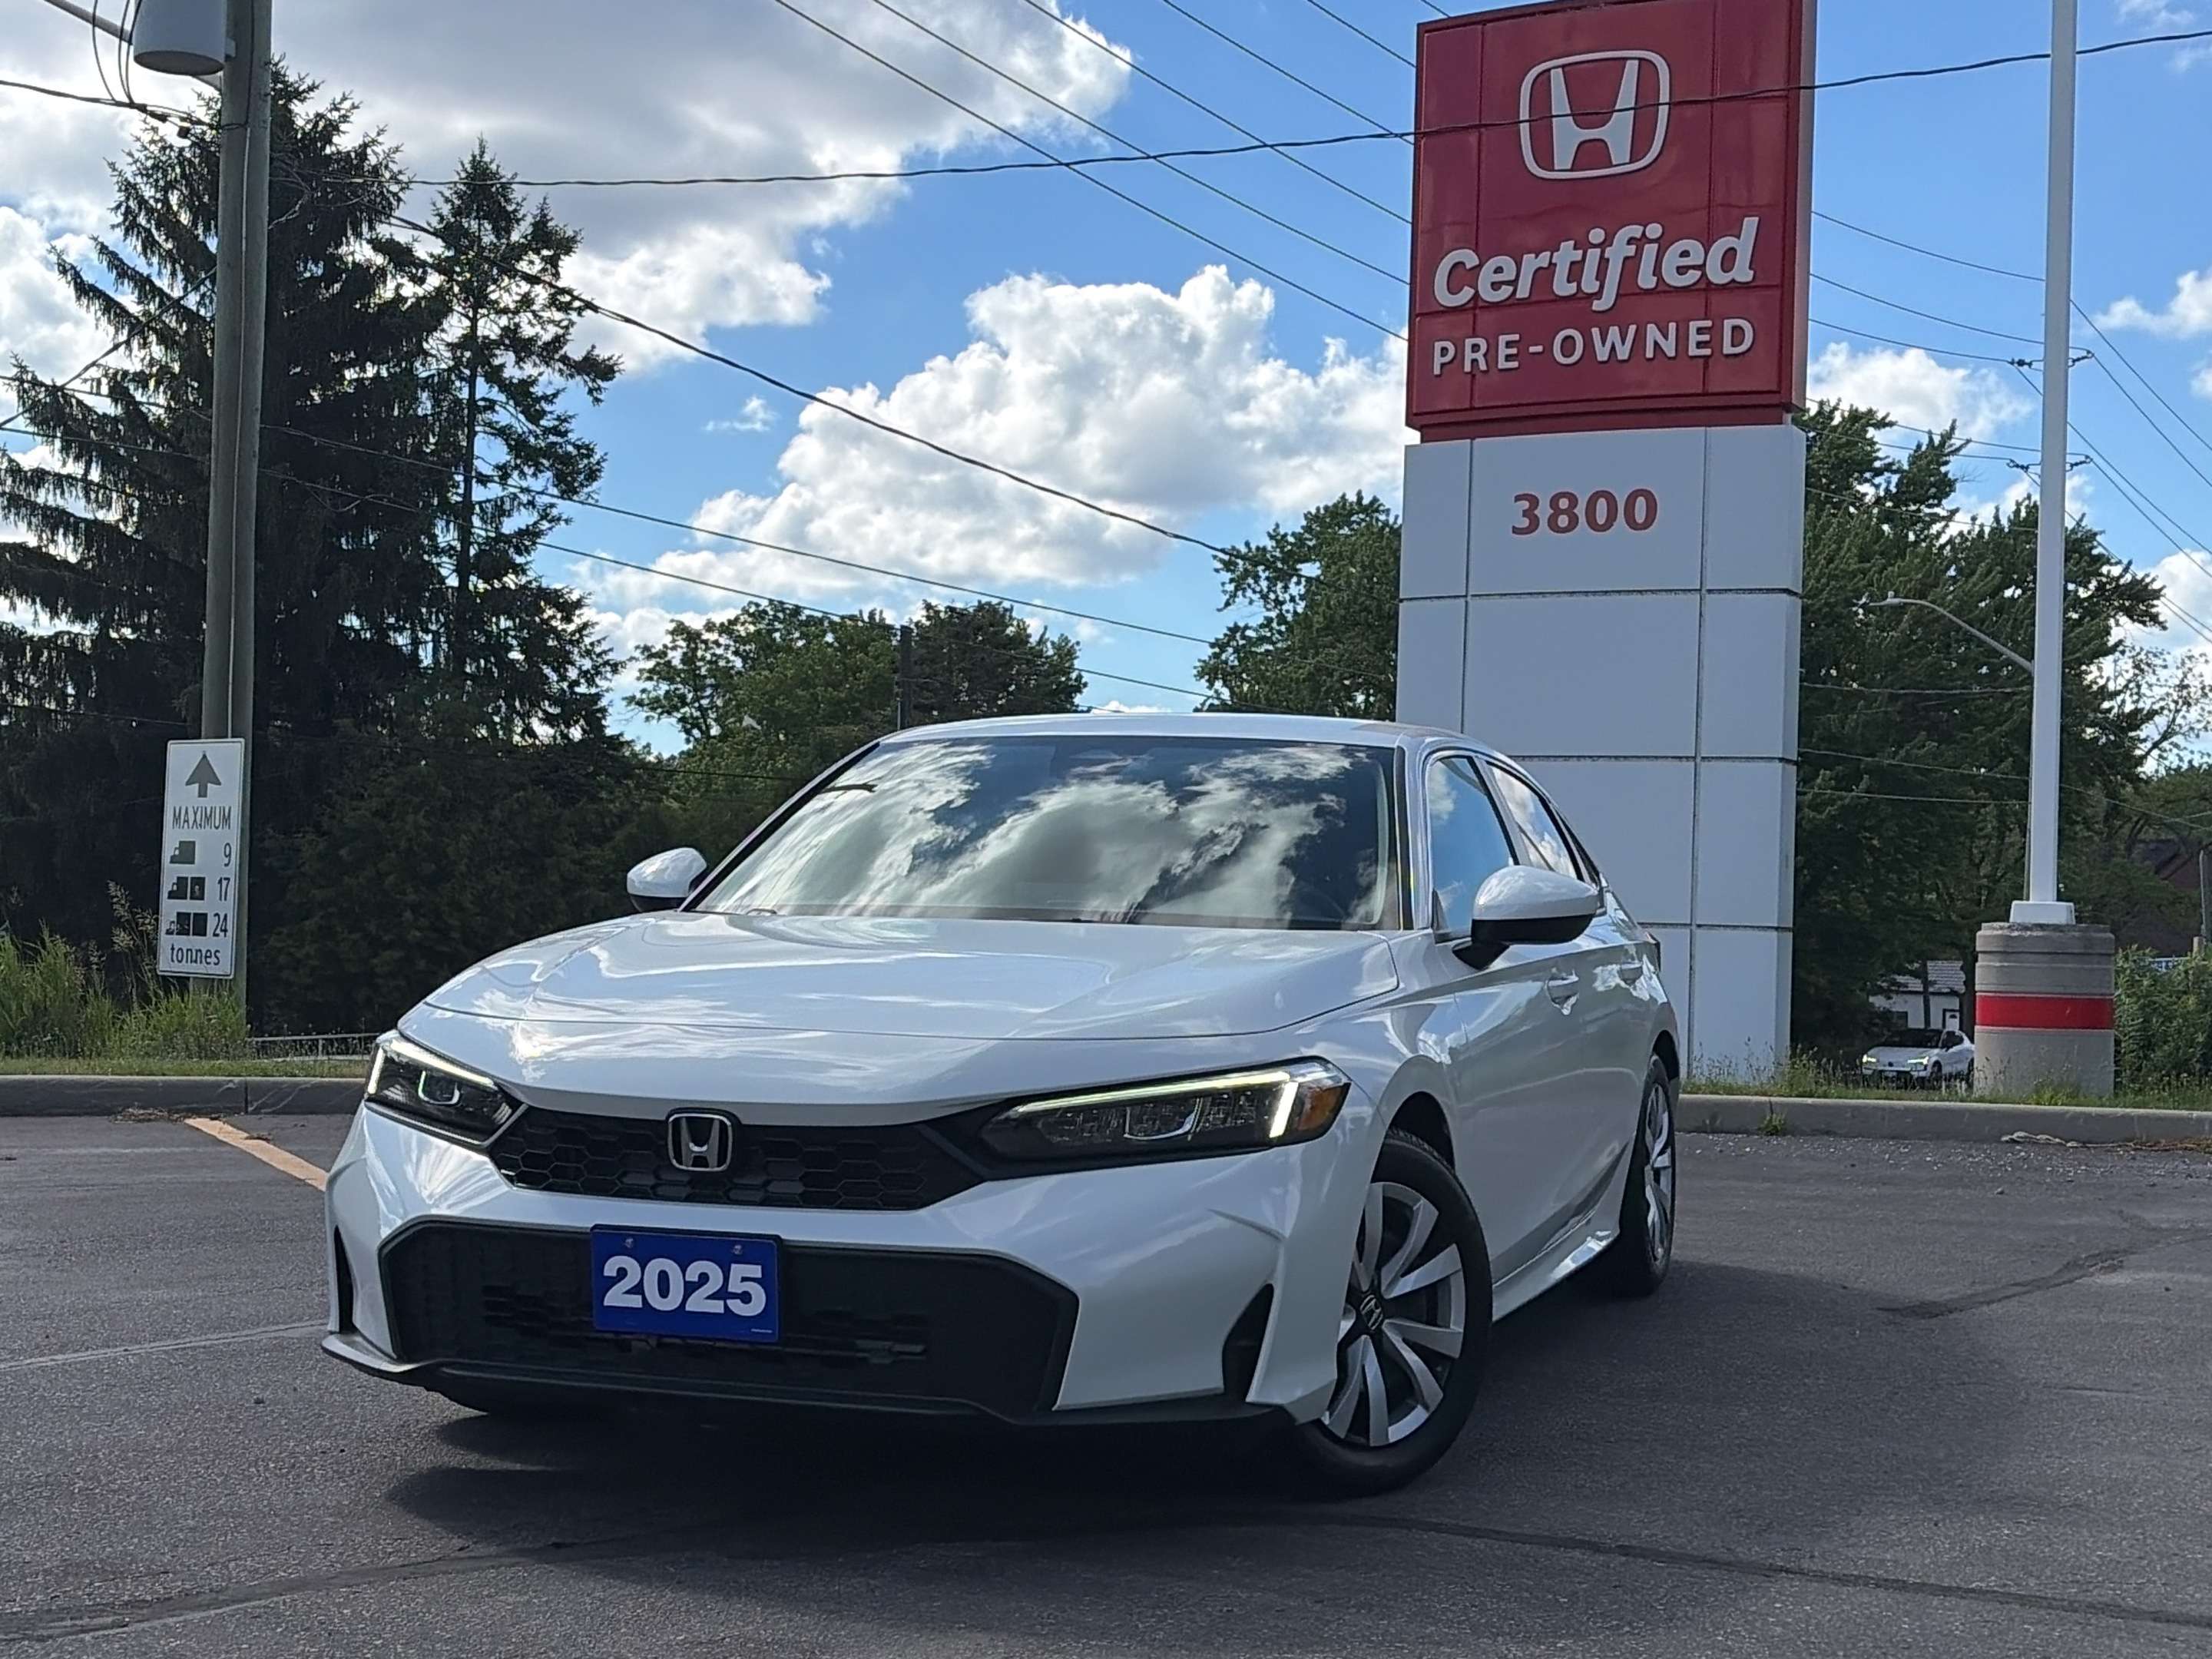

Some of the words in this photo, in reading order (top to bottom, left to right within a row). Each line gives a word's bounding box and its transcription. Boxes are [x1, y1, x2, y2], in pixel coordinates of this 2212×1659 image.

[1433, 216, 1760, 312] Certified
[1432, 318, 1754, 376] PRE-OWNED
[1511, 488, 1658, 535] 3800
[172, 805, 232, 830] MAXIMUM
[223, 842, 232, 868] 9
[217, 876, 231, 902] 17
[212, 912, 228, 938] 24
[170, 942, 221, 965] tonnes
[603, 1255, 767, 1316] 2025
